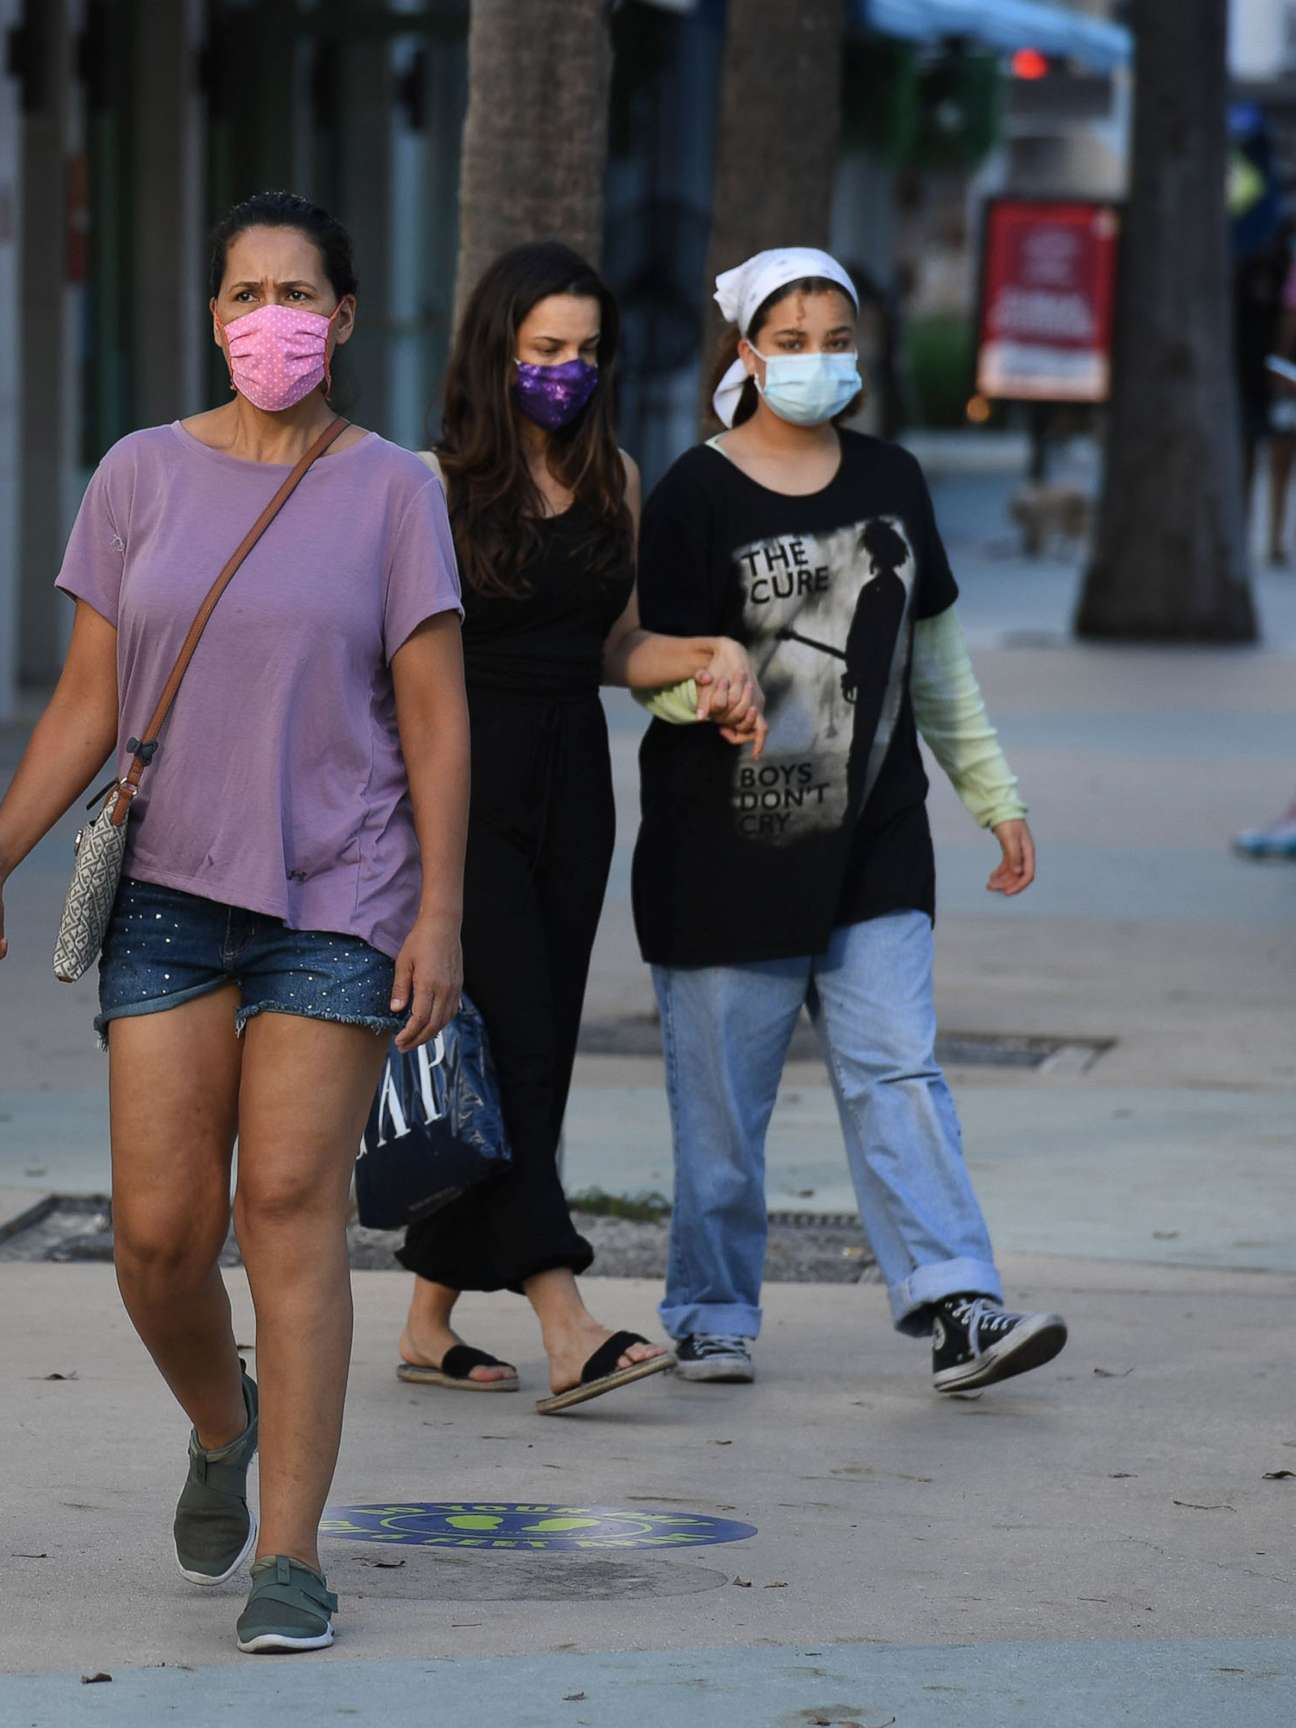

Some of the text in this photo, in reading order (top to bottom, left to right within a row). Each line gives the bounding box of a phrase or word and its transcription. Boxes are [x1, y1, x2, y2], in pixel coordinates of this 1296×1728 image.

[740, 541, 809, 577] THE
[750, 566, 829, 604] CURE
[740, 762, 812, 788] BOYS
[740, 782, 831, 811] DON'T
[355, 1030, 445, 1161] AP
[433, 1505, 591, 1514] YOUR
[423, 1537, 548, 1548] FEET
